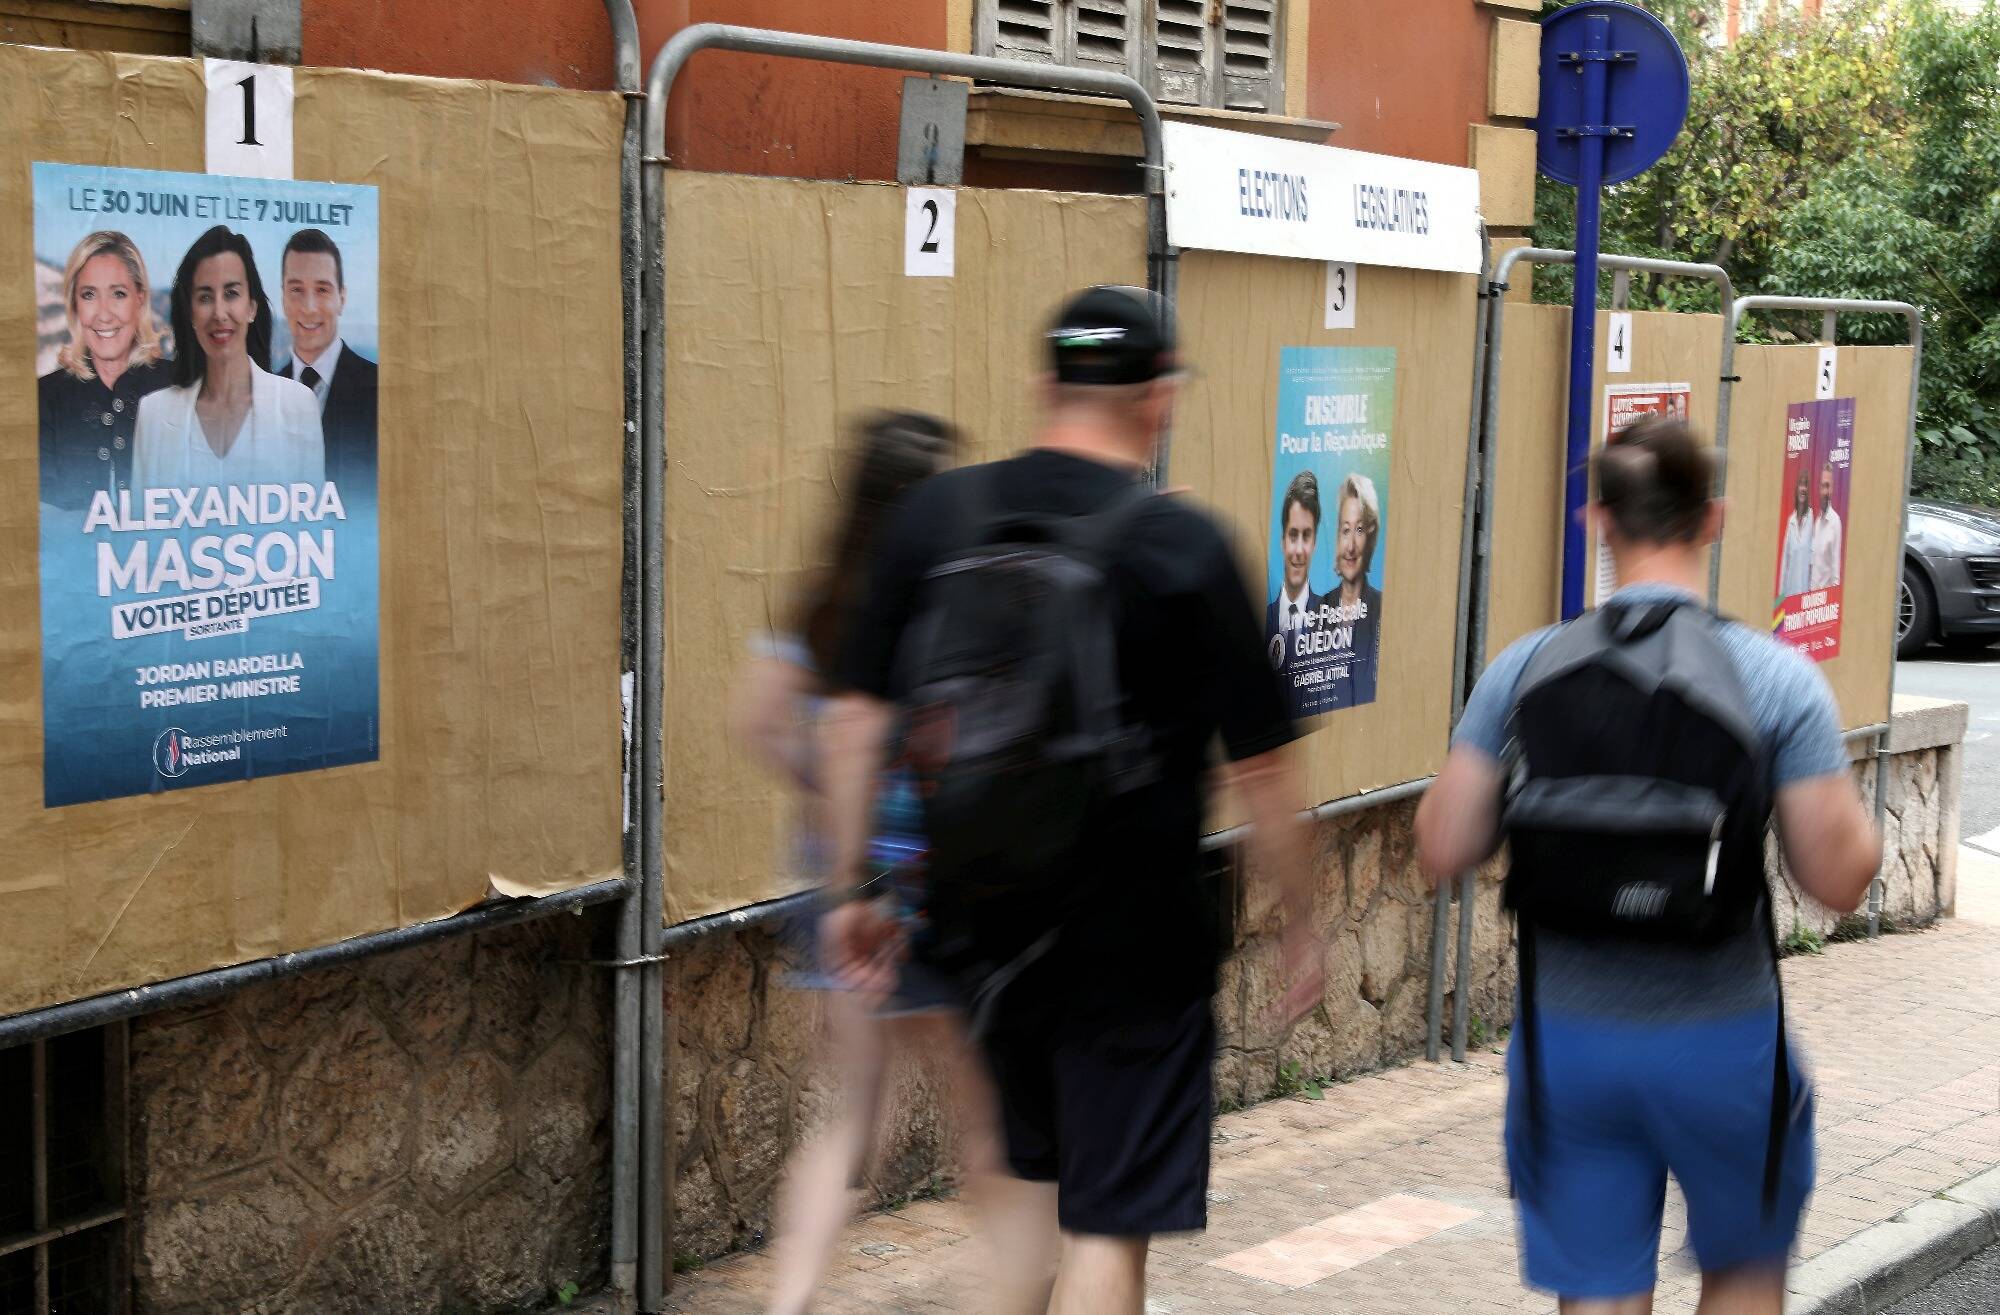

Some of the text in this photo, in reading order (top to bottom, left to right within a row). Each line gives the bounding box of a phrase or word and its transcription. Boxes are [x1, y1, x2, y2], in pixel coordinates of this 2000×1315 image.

[235, 75, 264, 146] 1
[68, 187, 97, 212] LE
[101, 190, 130, 214] 30
[134, 192, 189, 217] JUIN
[195, 194, 221, 218] ET
[225, 197, 250, 220] LE
[254, 200, 269, 221] 7
[273, 200, 353, 226] JUILLET
[1239, 168, 1429, 235] ELECTIONS LEGISLATIVES
[920, 199, 940, 254] 2
[1333, 267, 1345, 311] 3
[1614, 323, 1625, 359] 4
[1822, 360, 1832, 391] 5
[1305, 394, 1368, 425] ENSEMBLE
[1280, 428, 1387, 456] Pour la République
[83, 481, 346, 533] ALEXANDRA
[96, 529, 335, 597] MASSON
[120, 599, 201, 632] VOTRE
[190, 619, 244, 637] SORTANTE
[135, 652, 304, 686] JORDAN BARDELLA
[1294, 670, 1324, 688] GABRIEL
[1325, 664, 1350, 682] ATTAL
[140, 675, 301, 709] PREMIER MINISTRE
[181, 725, 288, 767] Rassemblement National
